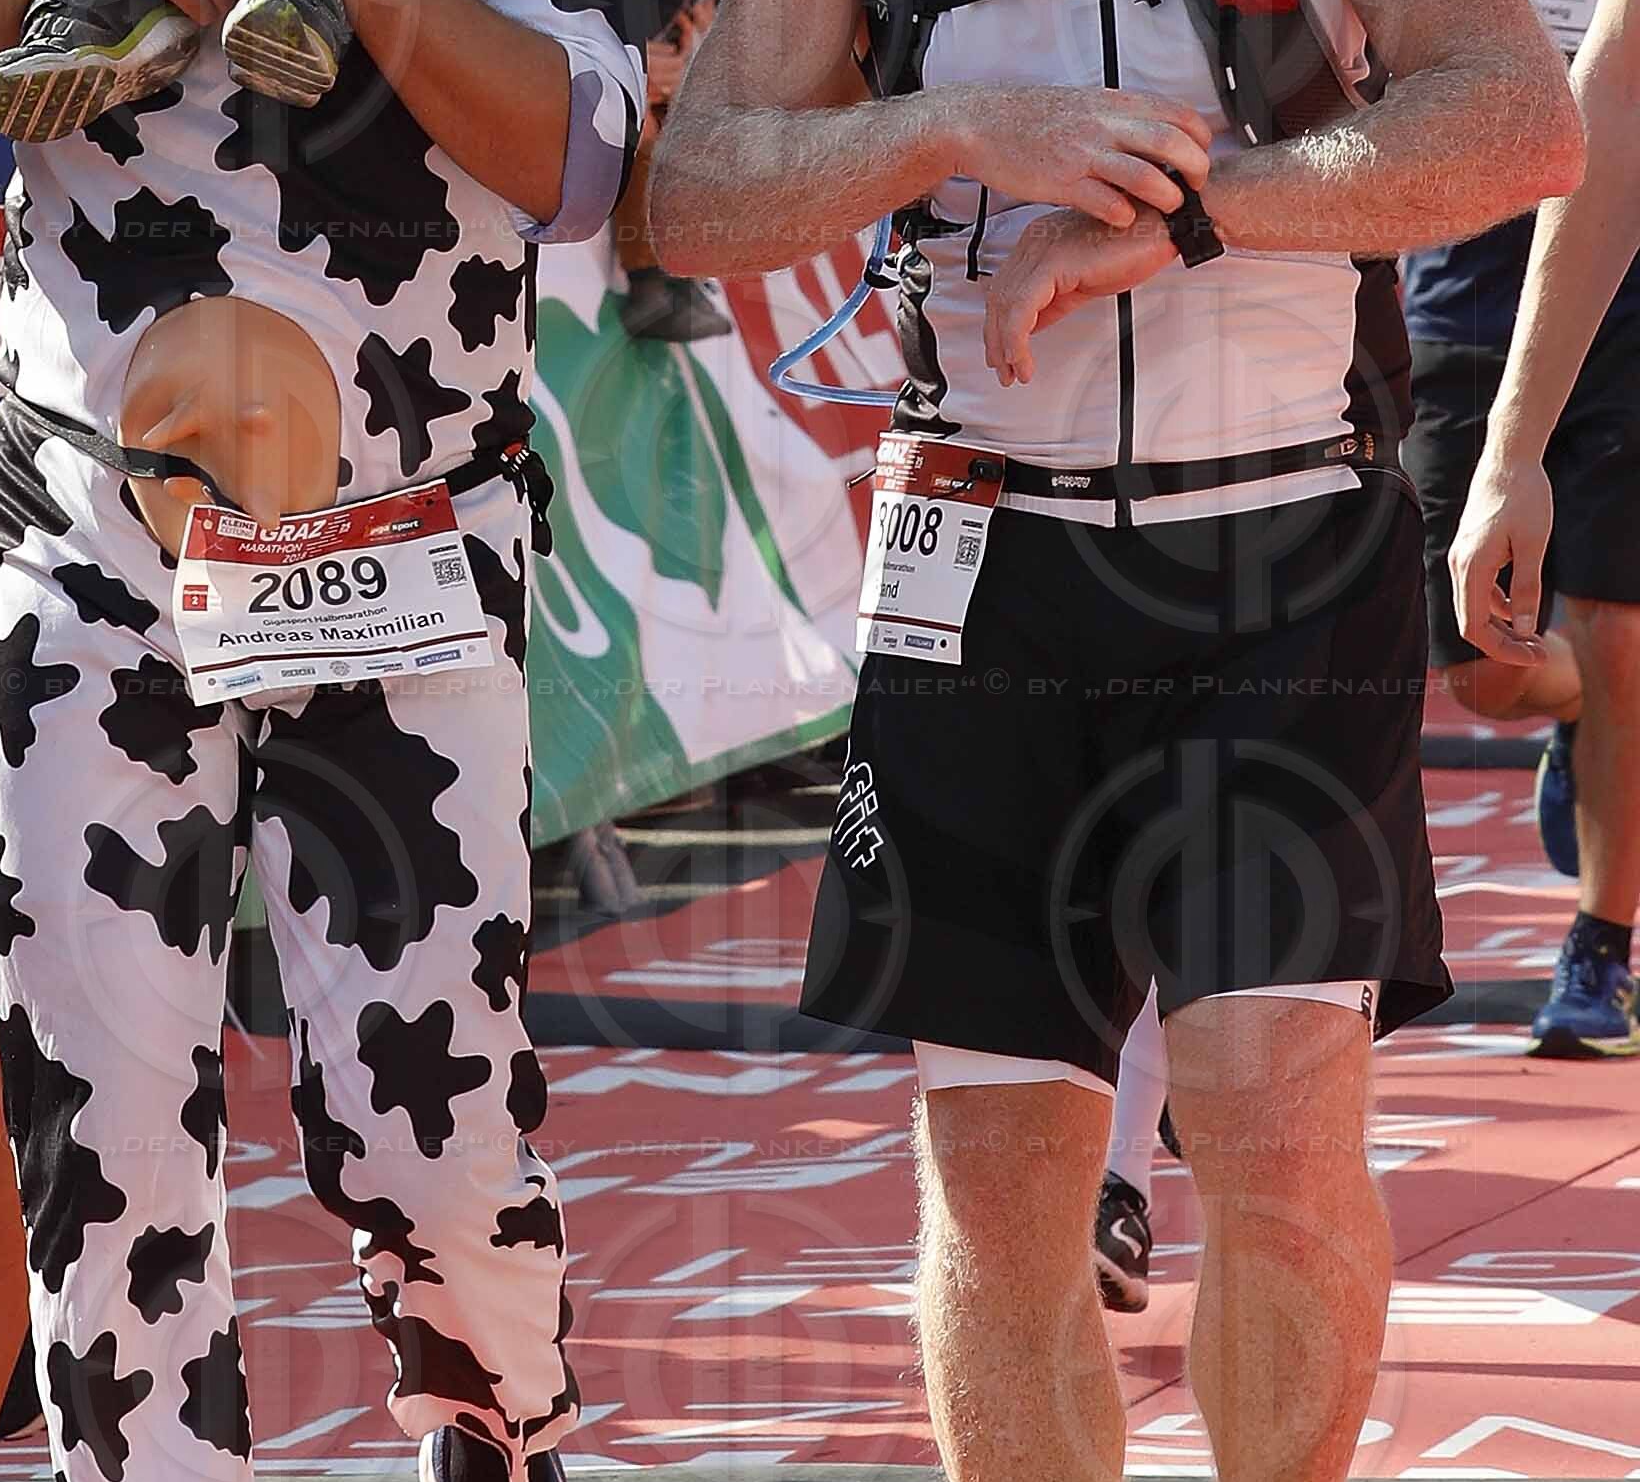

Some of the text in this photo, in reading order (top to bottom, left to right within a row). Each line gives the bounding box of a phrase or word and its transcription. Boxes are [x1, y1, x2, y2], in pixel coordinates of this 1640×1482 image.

[221, 518, 256, 531] KLEINE
[259, 519, 327, 542] GRAZ
[238, 542, 304, 554] MARATHON
[248, 555, 388, 614] 2089
[314, 605, 388, 623] Halbmarathon
[217, 610, 445, 648] Andreas Maximilian
